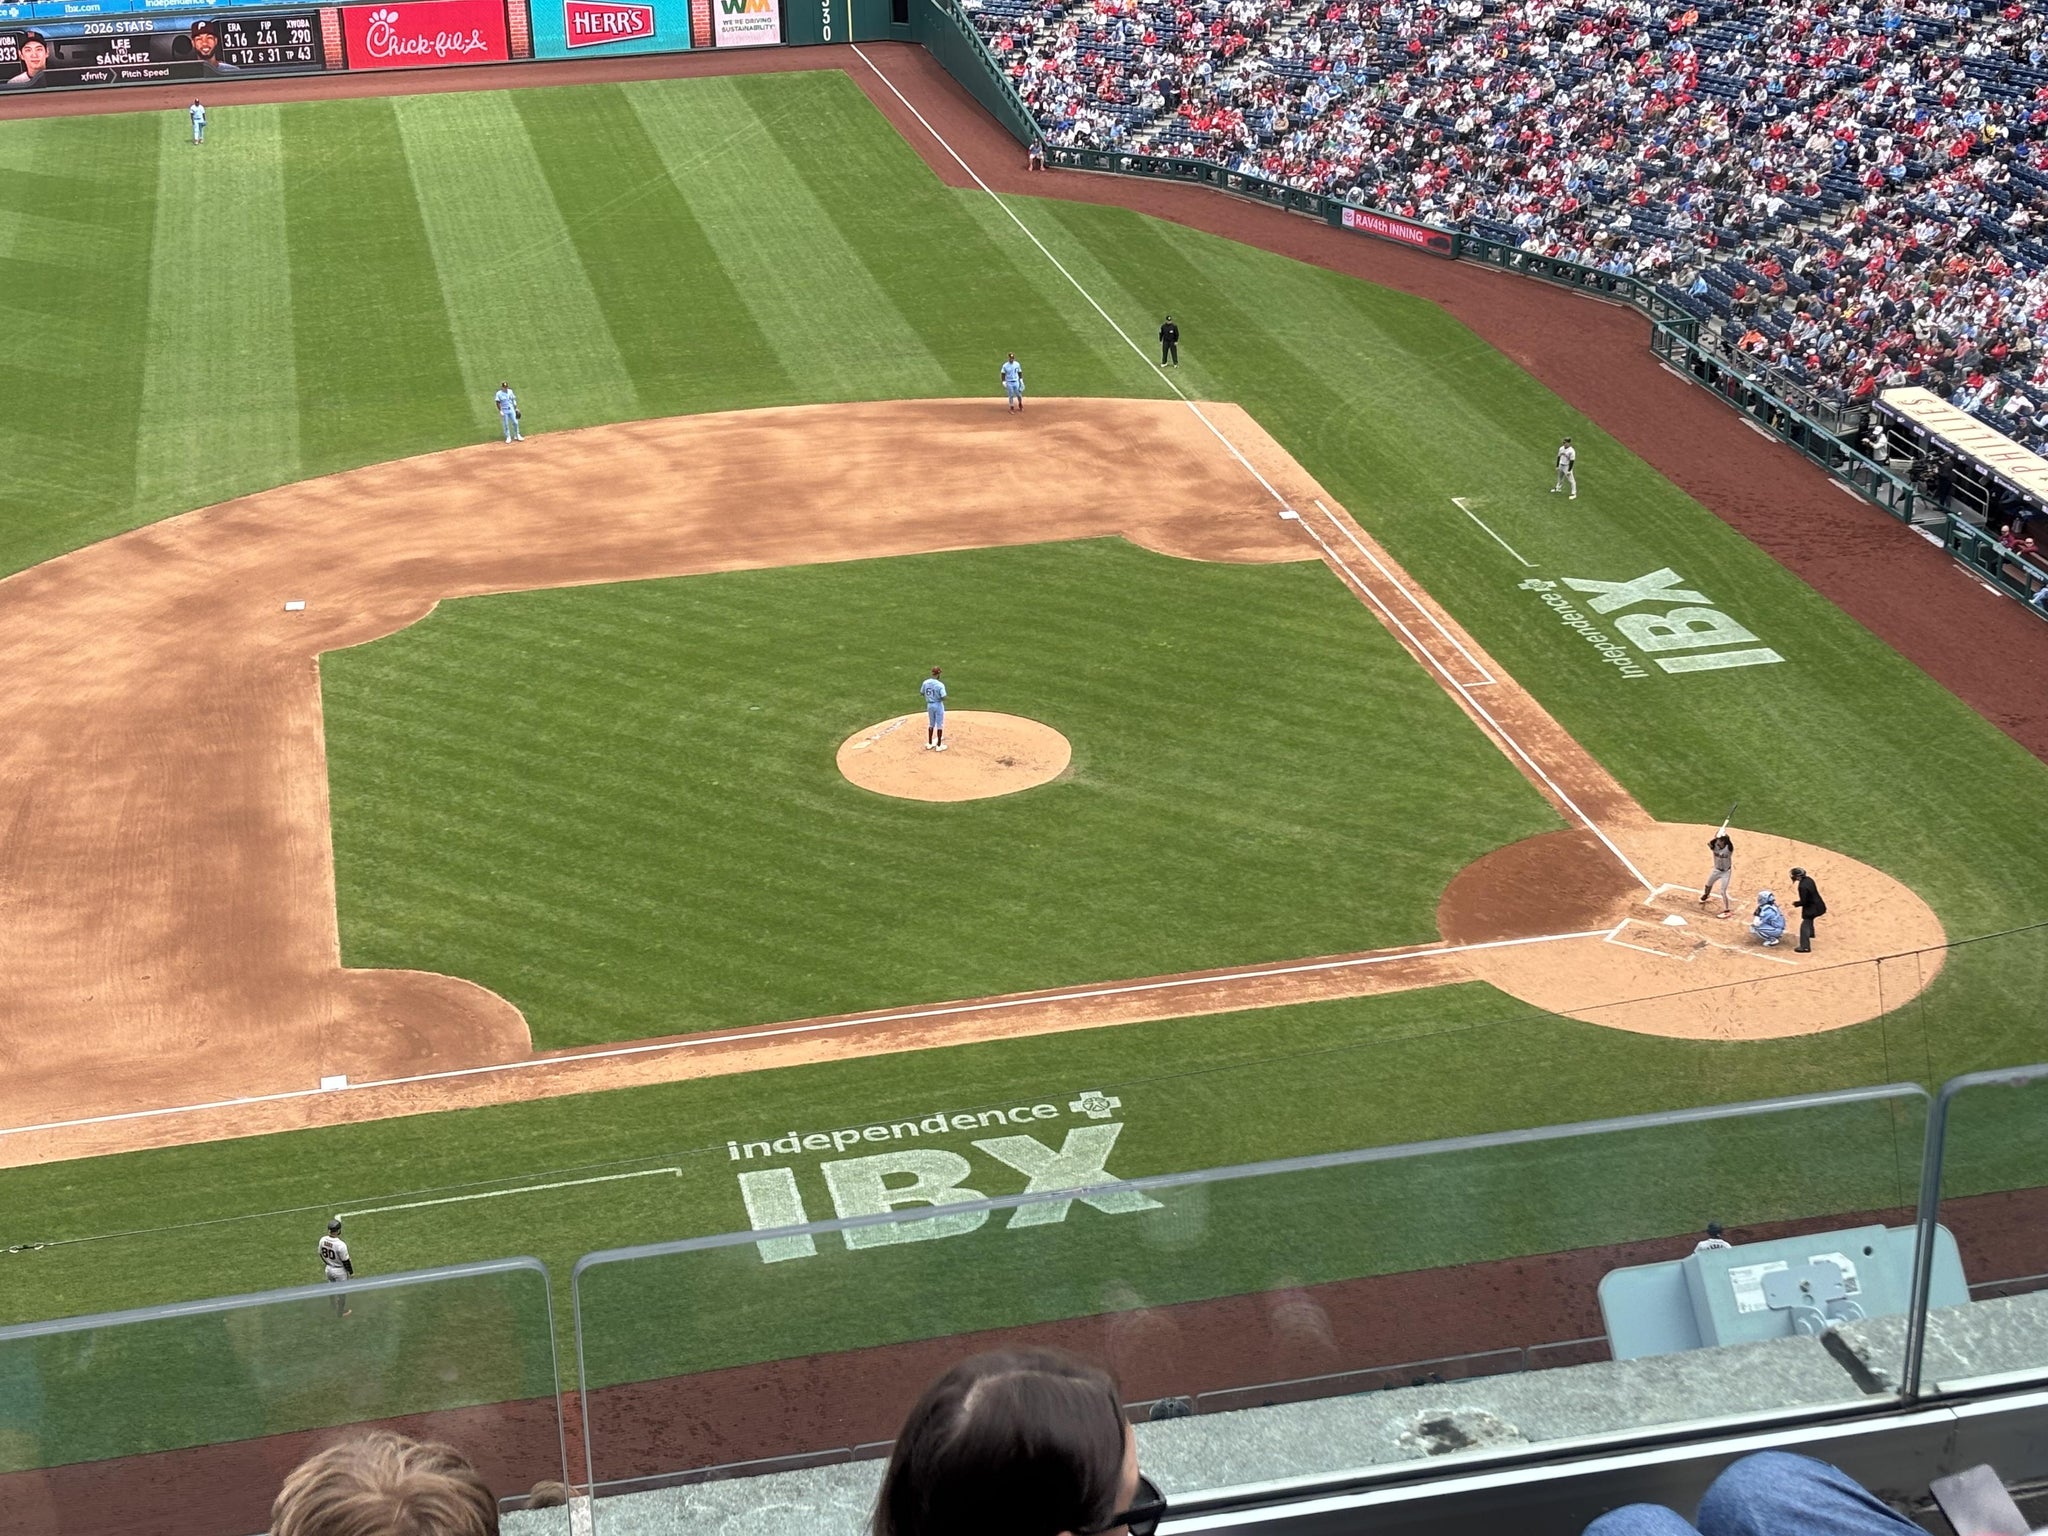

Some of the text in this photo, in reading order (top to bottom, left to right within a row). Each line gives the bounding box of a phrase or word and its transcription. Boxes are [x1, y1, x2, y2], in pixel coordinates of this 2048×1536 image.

[721, 0, 771, 14] WM
[84, 20, 153, 35] 2026 STATS
[228, 23, 241, 32] ERA
[260, 21, 272, 30] FIP
[573, 9, 643, 34] HERR'S
[111, 38, 131, 50] LEE
[224, 29, 311, 48] 3.16 2.61 .290
[366, 20, 488, 58] Chick-fil-A
[96, 52, 150, 65] SÁNCHEZ
[232, 47, 311, 64] B 12 S 31 TP 43
[121, 69, 142, 79] Pitch
[143, 68, 170, 78] Speed
[1355, 213, 1424, 243] RAV4th INNING
[1897, 398, 2048, 474] PHILLIES
[1561, 567, 1786, 674] IBX
[737, 1122, 1165, 1264] IBX
[321, 1246, 337, 1261] 80
